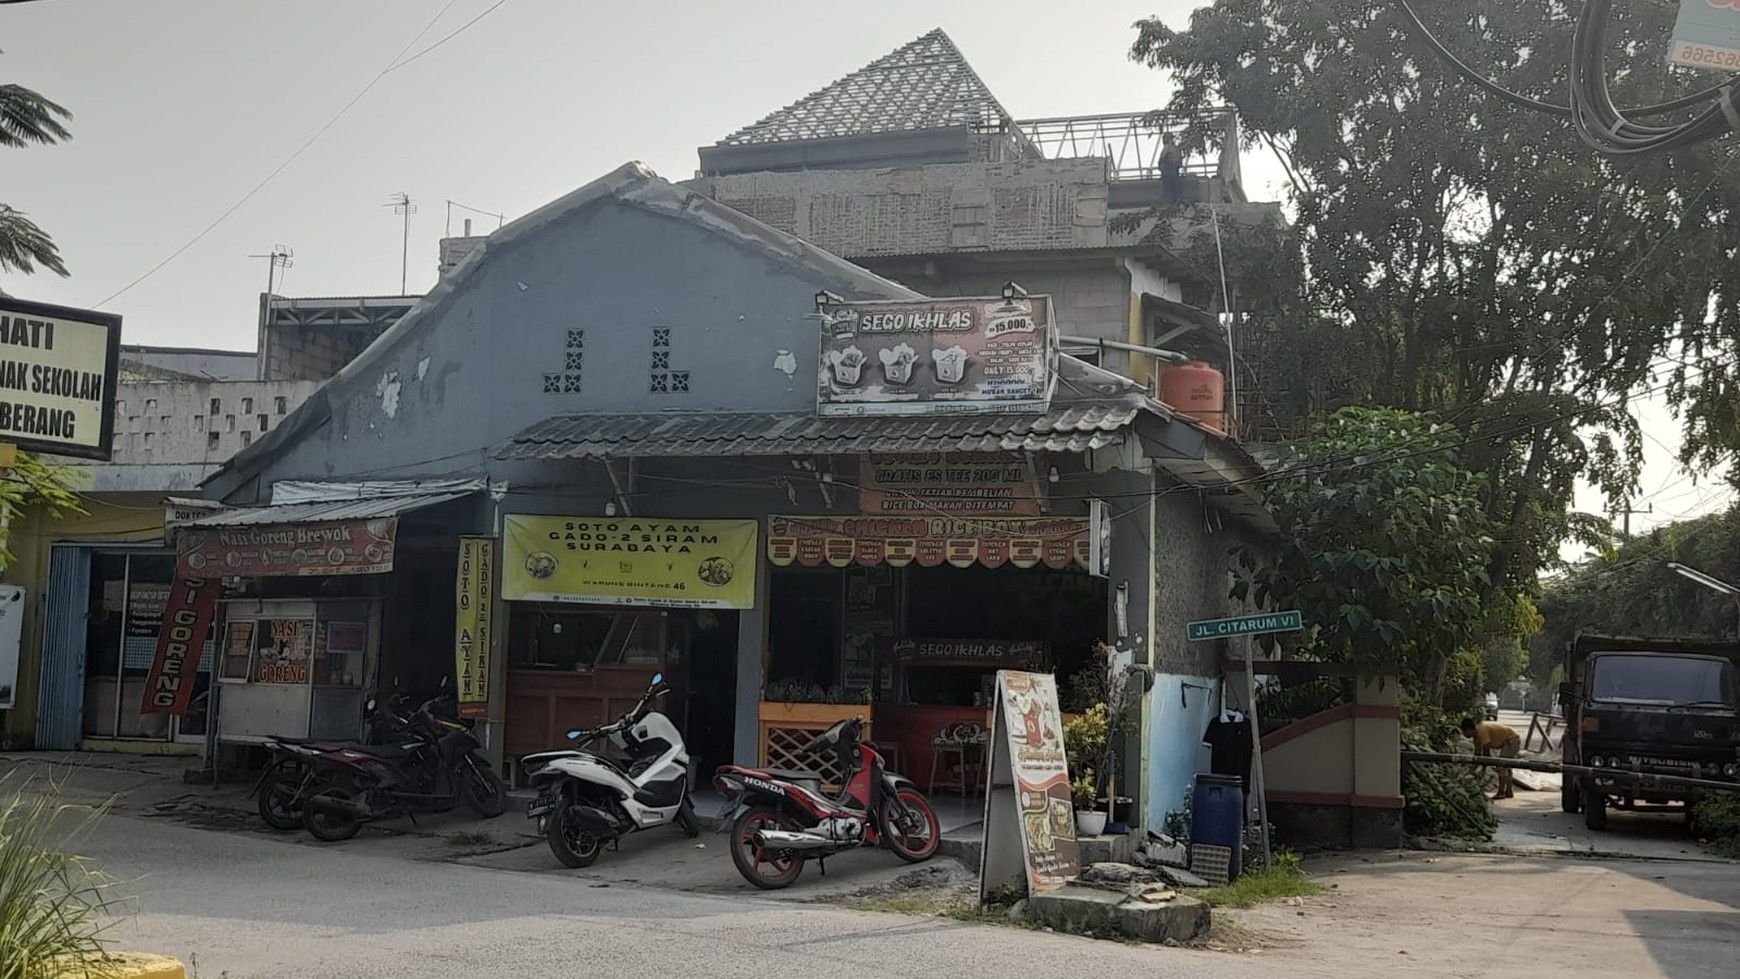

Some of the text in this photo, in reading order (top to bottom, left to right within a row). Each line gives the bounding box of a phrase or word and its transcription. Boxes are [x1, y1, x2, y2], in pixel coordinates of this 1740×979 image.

[861, 314, 905, 331] SEGO
[0, 315, 55, 351] HATI
[31, 364, 102, 402] SEKOLAH
[0, 401, 76, 439] BERANG
[875, 469, 922, 483] GRATIS
[924, 470, 943, 482] ES
[945, 470, 971, 482] TEE
[955, 488, 1013, 497] PEMBELIAN
[881, 501, 1015, 510] RICE BOX MAKAN DITEMPAT
[175, 511, 206, 520] DOKTE
[220, 524, 352, 548] Nasi Goreng Brewok
[565, 522, 701, 533] SOTO AYAM
[842, 518, 928, 536] CHICKEN
[930, 518, 979, 536] RICE
[980, 518, 1024, 536] BOX
[548, 532, 719, 545] GADO-2 SIRAM
[566, 543, 692, 554] SURABAYA
[673, 582, 686, 591] 46
[272, 619, 298, 638] NASI
[459, 543, 473, 696] SOTO AYAM
[1196, 616, 1294, 636] JL. CITARUM VI
[152, 609, 198, 708] GORENG
[919, 643, 951, 656] SEGO
[477, 627, 487, 696] SIRAM
[259, 664, 306, 683] GORENG
[1628, 755, 1701, 769] MITSUBISH
[744, 776, 786, 796] HONDA
